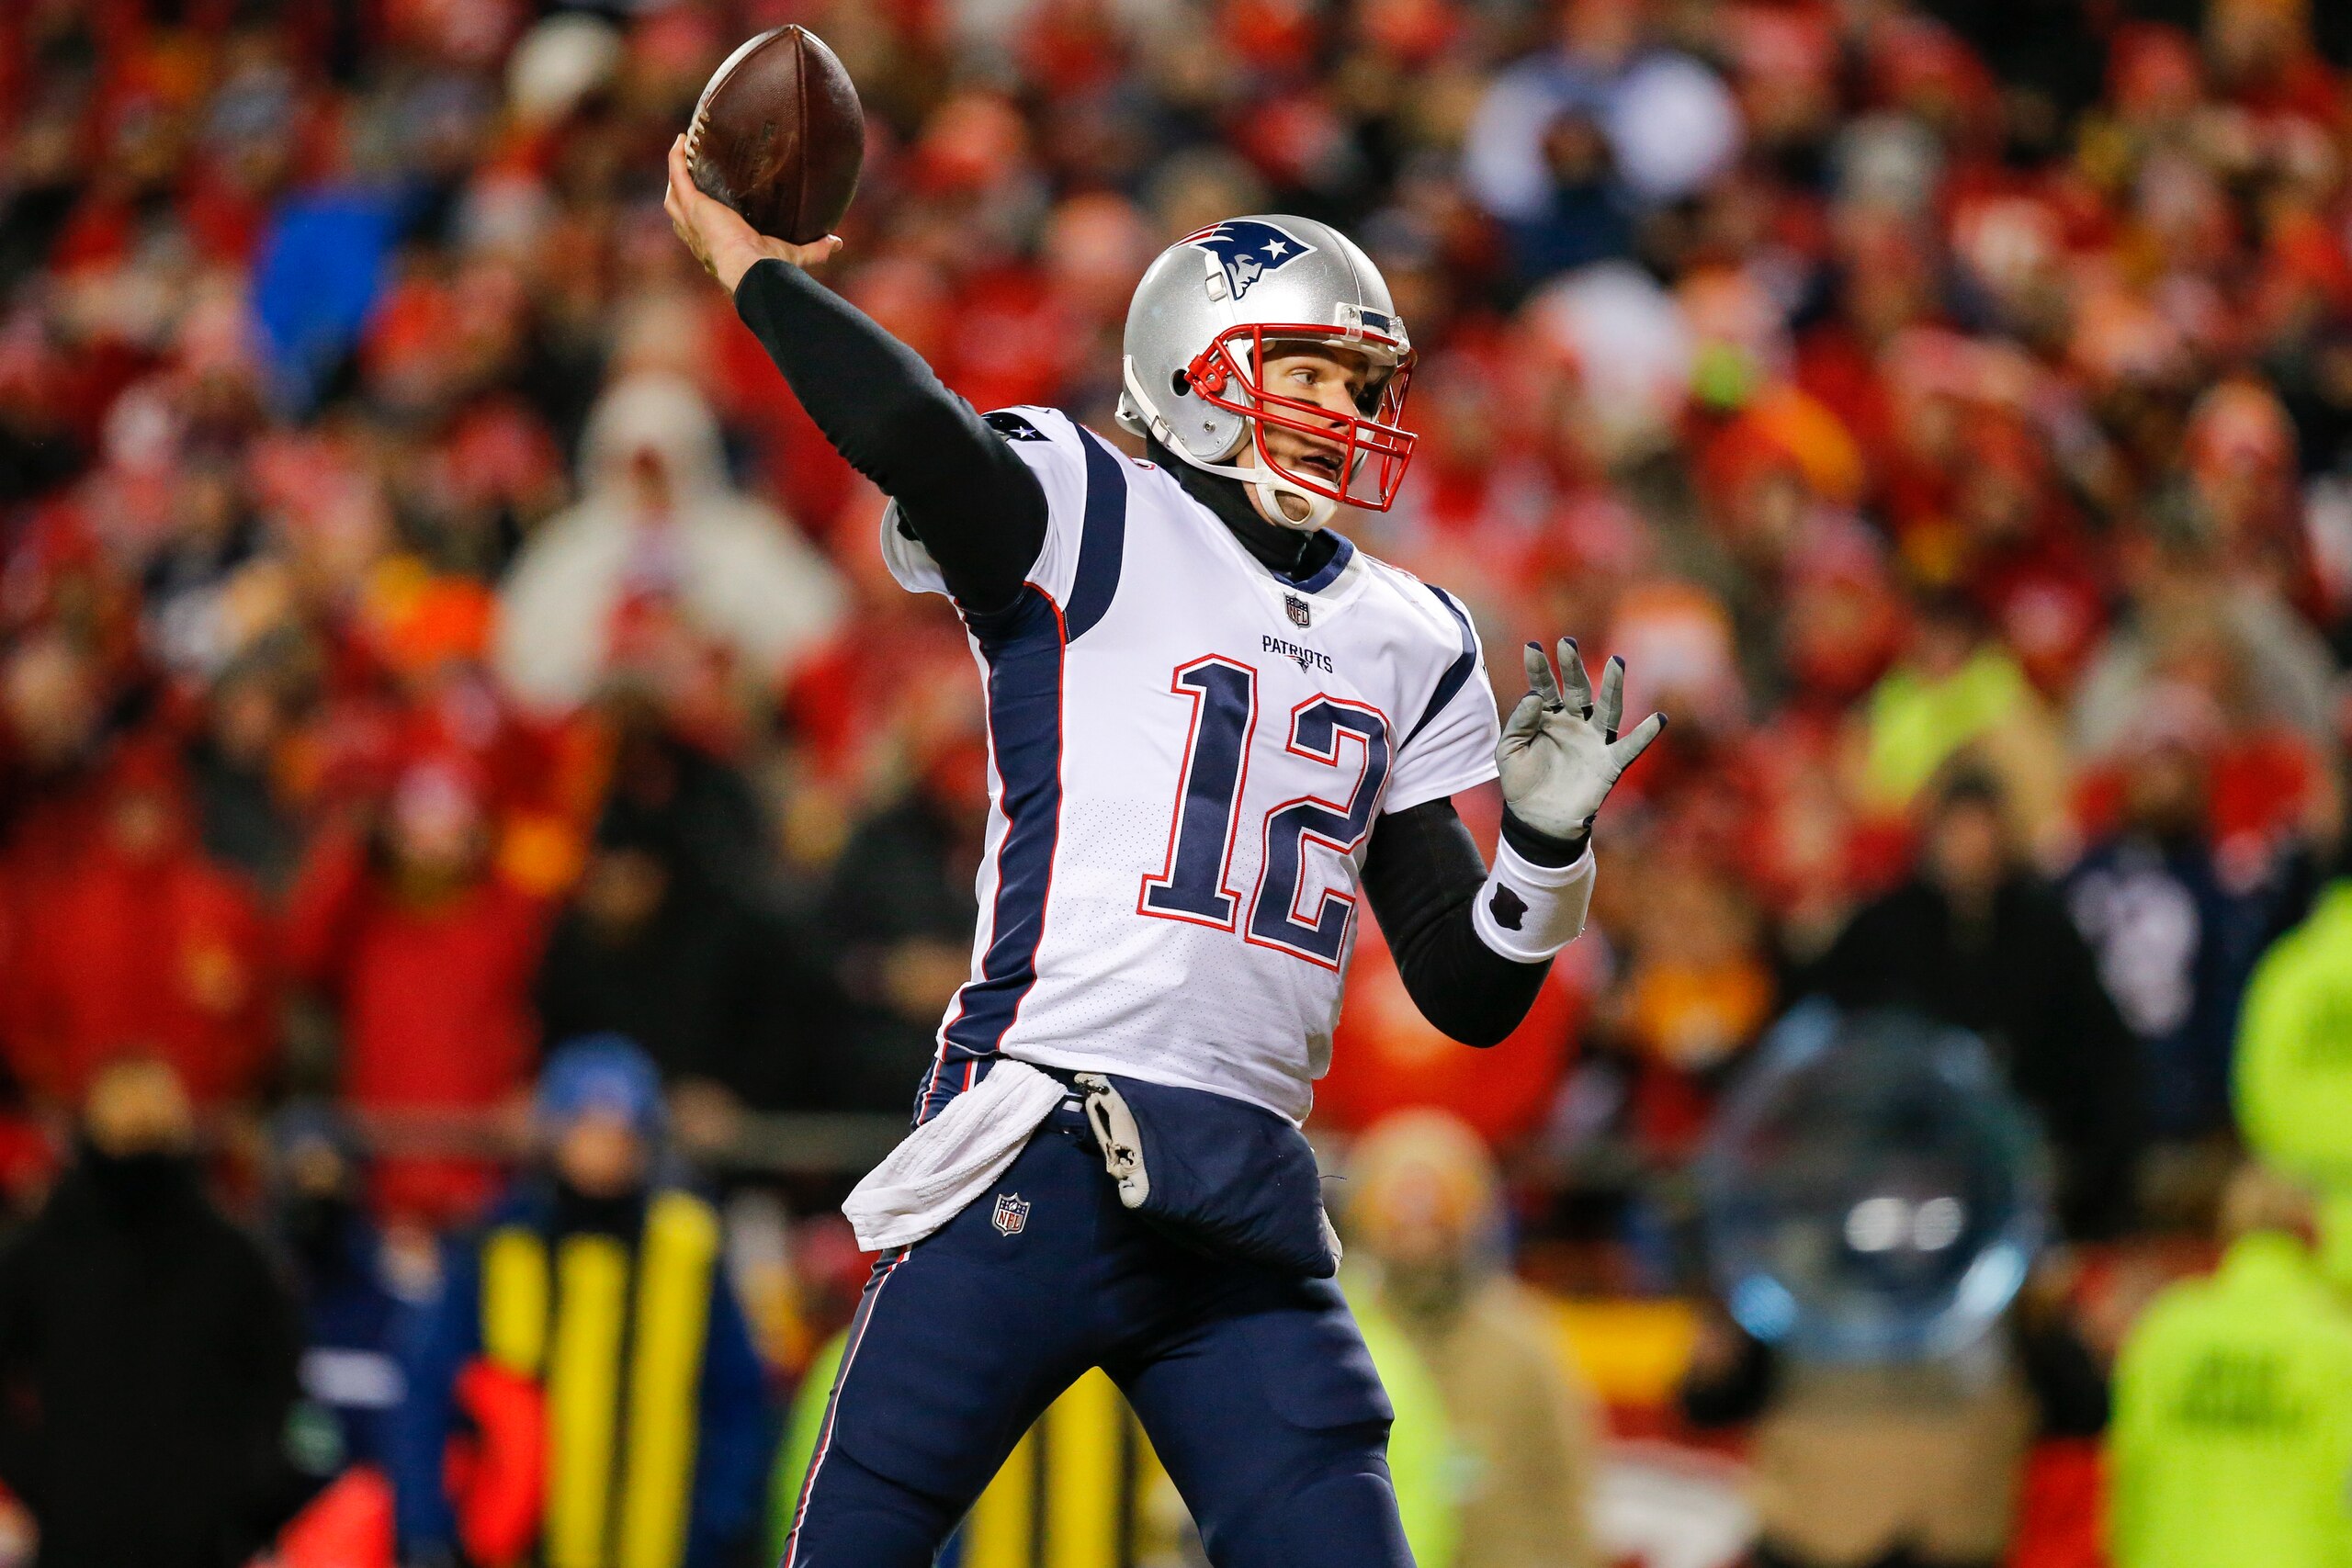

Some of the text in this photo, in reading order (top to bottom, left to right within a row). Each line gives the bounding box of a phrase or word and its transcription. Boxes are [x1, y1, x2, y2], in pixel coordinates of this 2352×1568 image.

[1287, 605, 1307, 624] NFL
[1262, 635, 1333, 673] PATRIOTS
[1136, 653, 1393, 972] 12
[998, 1211, 1020, 1229] NFL
